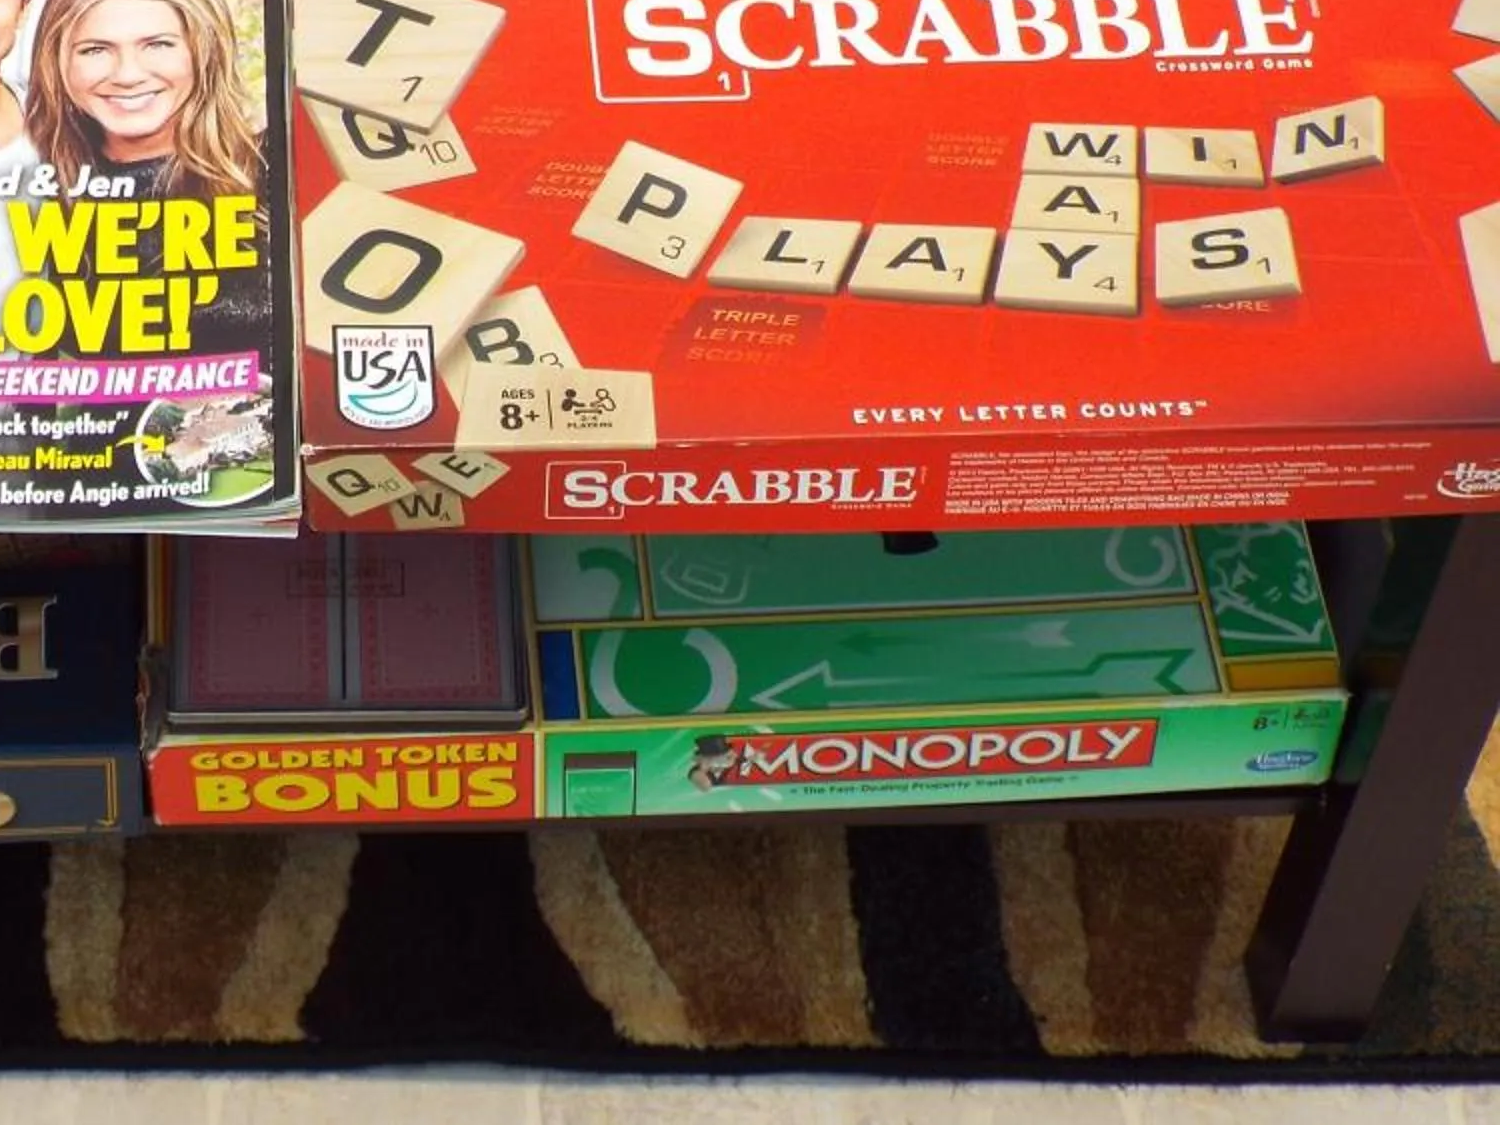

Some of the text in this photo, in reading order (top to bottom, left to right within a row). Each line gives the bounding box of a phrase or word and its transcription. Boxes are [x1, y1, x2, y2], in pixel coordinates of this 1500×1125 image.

[72, 166, 136, 198] Jen
[7, 195, 259, 276] WE'RE
[342, 331, 398, 348] made
[104, 366, 133, 395] IN
[138, 359, 251, 393] FRANCE
[342, 350, 427, 390] USA
[853, 406, 944, 424] EVERY
[960, 403, 1067, 421] LETTER
[35, 446, 112, 469] Miraval
[0, 481, 65, 504] before
[69, 480, 130, 506] Angie
[132, 473, 210, 501] arrived!
[563, 465, 918, 510] SCRABBLE
[190, 742, 518, 772] GOLDEN TOKEN
[739, 726, 1142, 777] MONOPOLY
[194, 767, 518, 814] BONUS
